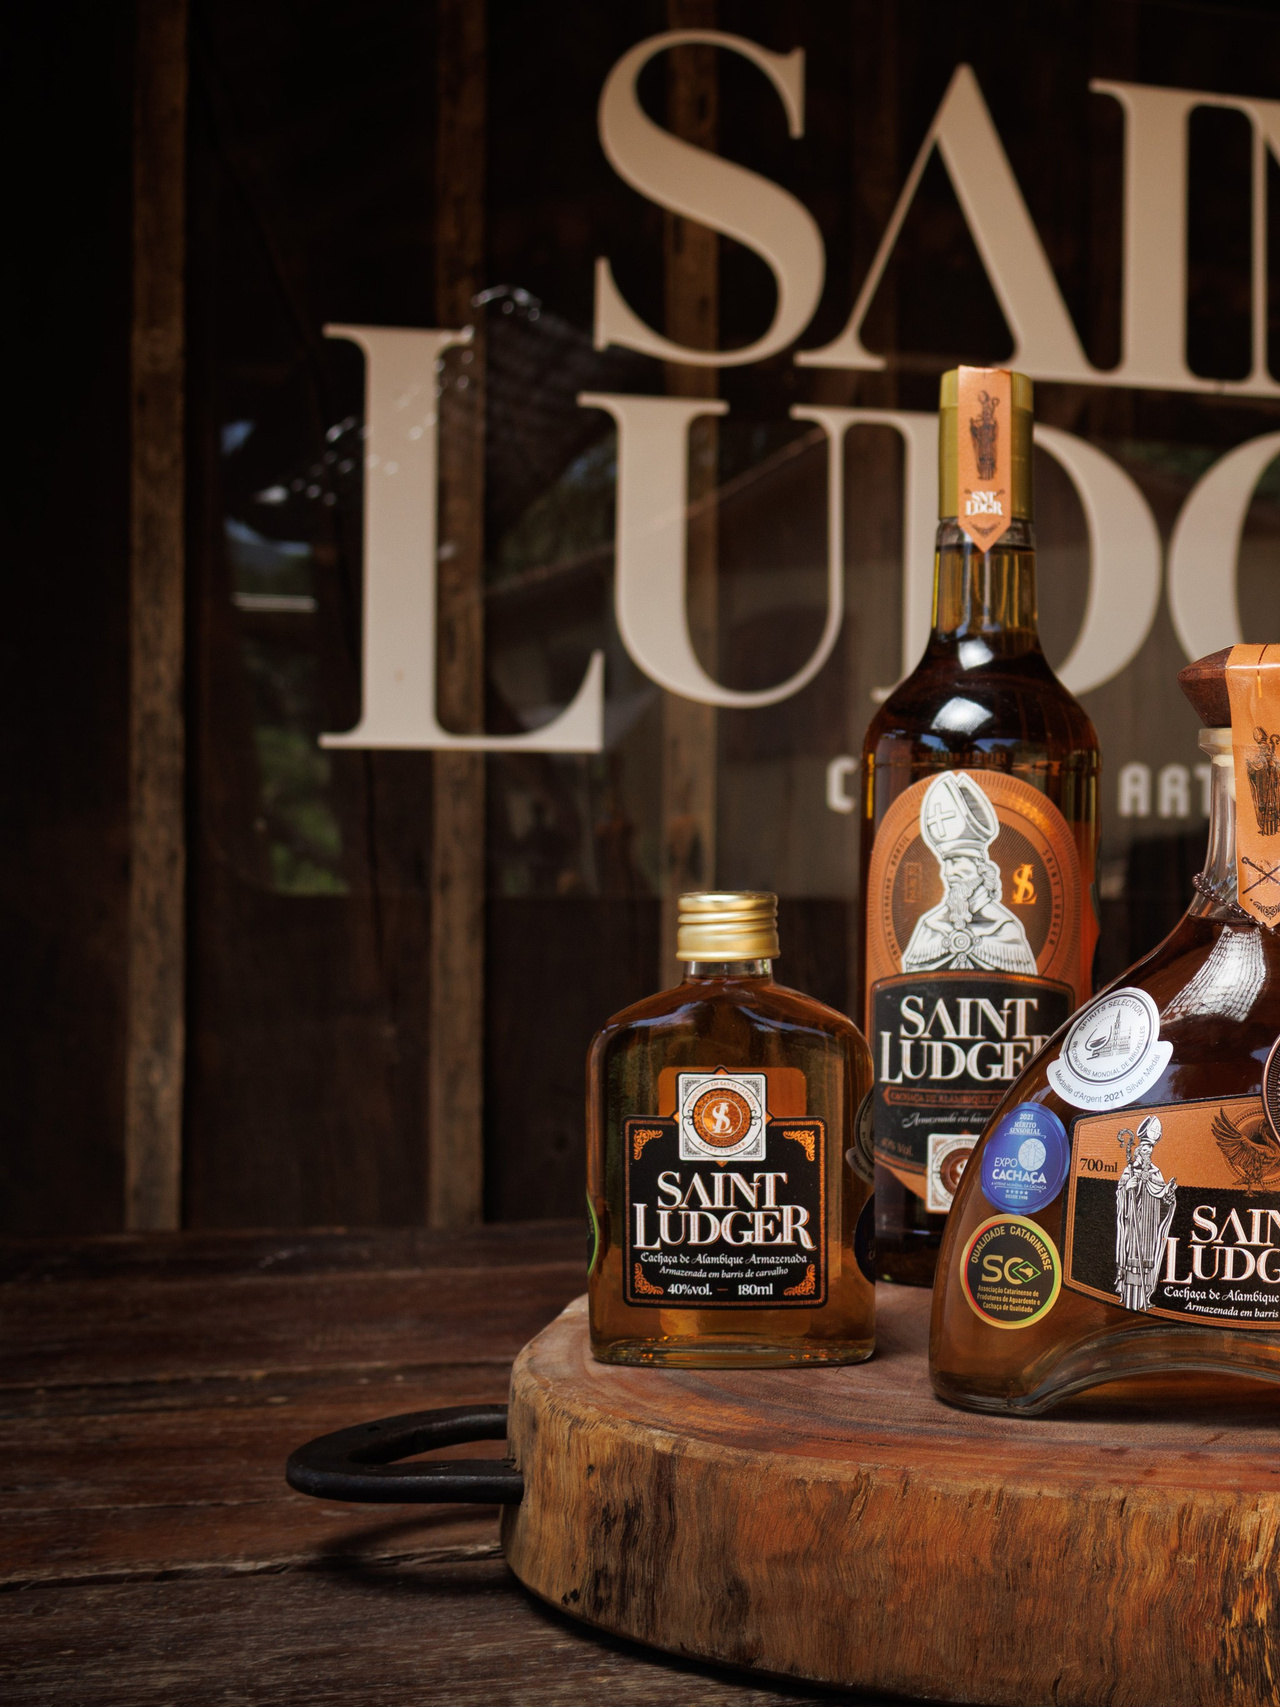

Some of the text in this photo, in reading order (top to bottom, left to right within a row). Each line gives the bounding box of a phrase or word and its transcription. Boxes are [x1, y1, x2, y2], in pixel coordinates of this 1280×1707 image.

[971, 490, 997, 502] SNT
[965, 500, 1003, 516] LDGR
[900, 995, 1038, 1040] SAINT
[1079, 998, 1145, 1032] SPIRITS SELECTION
[1071, 1049, 1092, 1076] CONCOURS
[1091, 1068, 1121, 1078] MONDIAL
[1121, 1061, 1130, 1070] DE
[1129, 1025, 1146, 1064] BRUXELLES
[1055, 1069, 1074, 1094] Médaille
[1104, 1090, 1125, 1103] 2021
[1125, 1076, 1145, 1094] Silver
[1143, 1054, 1161, 1077] Medal
[1013, 1120, 1037, 1129] MÉRITO
[1019, 1113, 1034, 1121] 2021
[1009, 1127, 1041, 1135] SENSORIAL
[994, 1157, 1018, 1168] EXPO
[992, 1168, 1047, 1185] CACHAÇA
[657, 1170, 788, 1210] SAINT
[633, 1203, 818, 1251] LUDGER
[970, 1225, 1053, 1271] QUALIDADE CATARINENSE
[640, 1252, 808, 1267] Cachaça de Alambique Armazenada
[659, 1265, 789, 1279] Armazenada em barris de carvalho
[981, 1254, 1024, 1285] SC
[667, 1283, 774, 1296] 40%vol. 180ml
[978, 1285, 1004, 1295] Associação
[1003, 1287, 1033, 1297] Catarinense
[1163, 1285, 1207, 1301] Cachaça
[1208, 1288, 1221, 1300] de
[1222, 1289, 1280, 1306] Alambique
[977, 1292, 1002, 1302] Produtores
[1009, 1296, 1037, 1306] Aguardente
[982, 1301, 1002, 1311] Cachaça
[1009, 1304, 1033, 1313] Qualidade
[1184, 1302, 1239, 1317] Armazenada
[1240, 1308, 1253, 1317] em
[1254, 1306, 1280, 1318] barris
